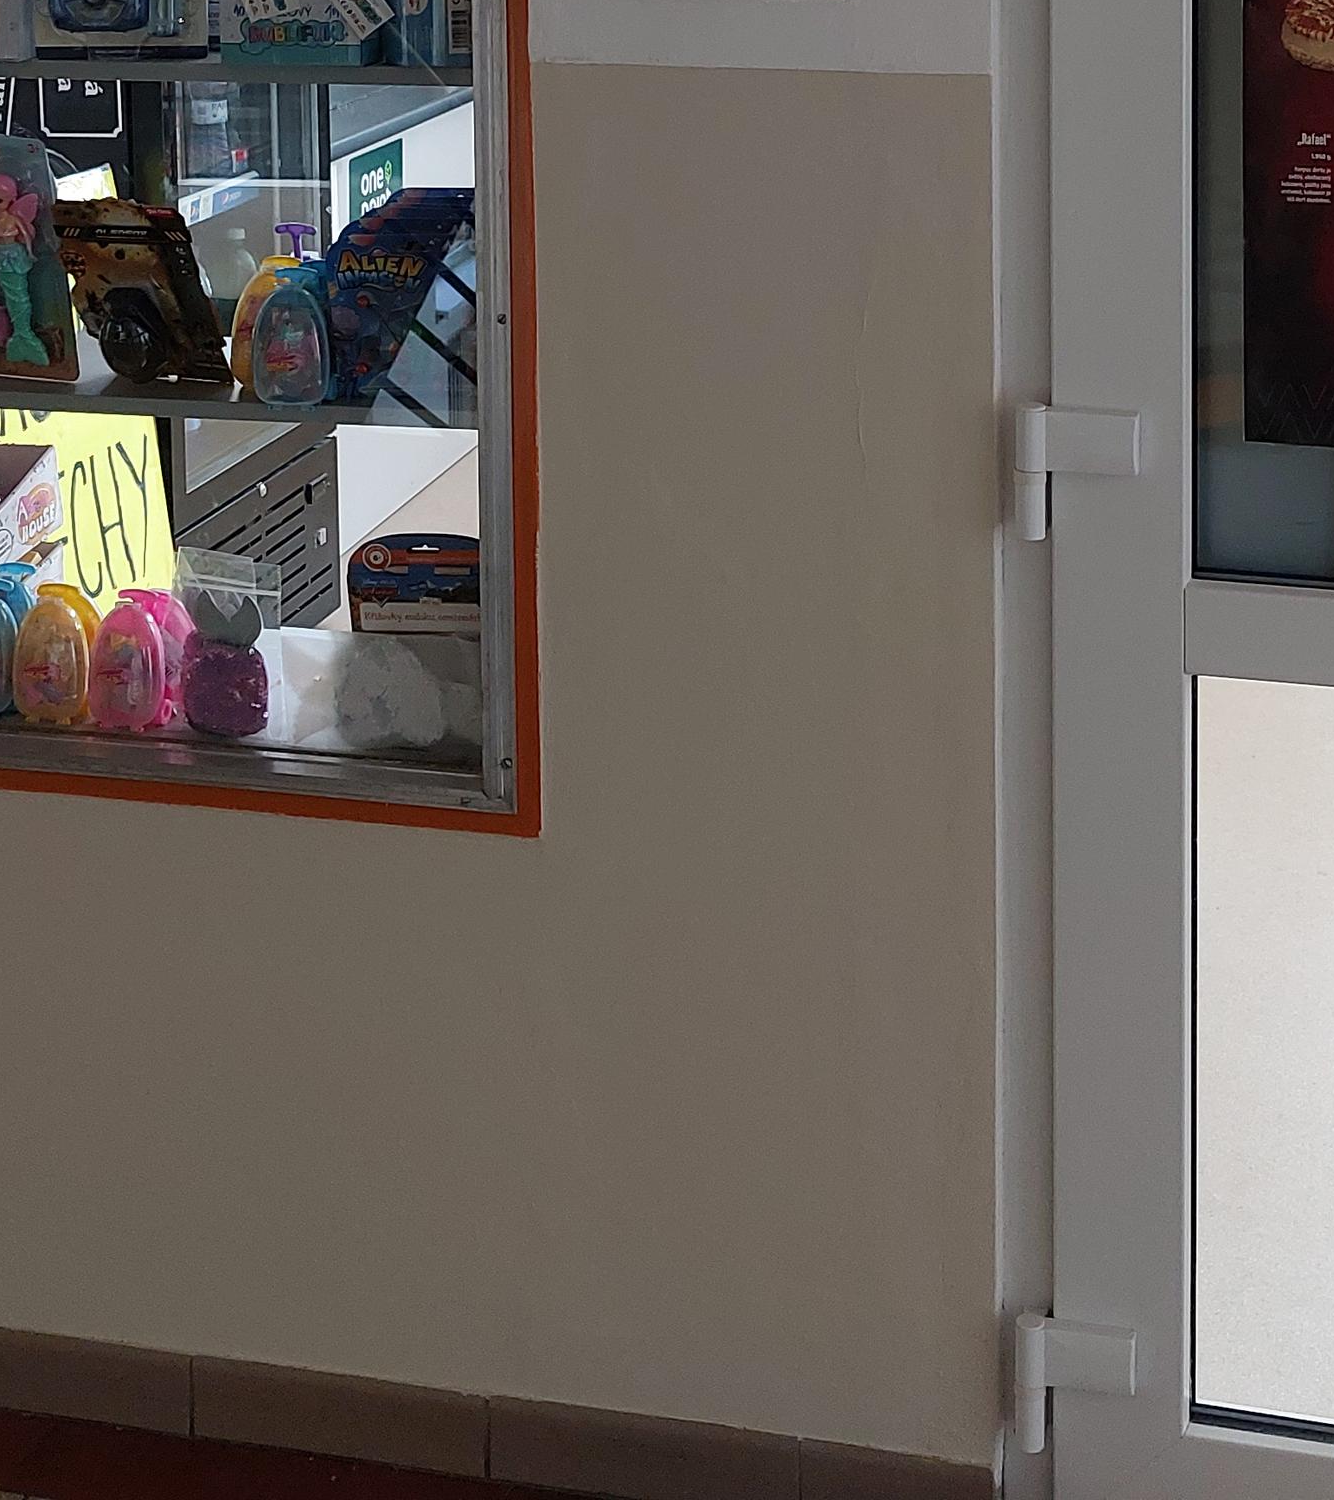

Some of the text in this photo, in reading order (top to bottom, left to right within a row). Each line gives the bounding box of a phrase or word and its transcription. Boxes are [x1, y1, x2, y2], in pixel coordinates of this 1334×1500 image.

[360, 166, 384, 197] one
[338, 248, 427, 277] ALIEN
[20, 500, 58, 543] HOUSE
[58, 432, 149, 599] CHY
